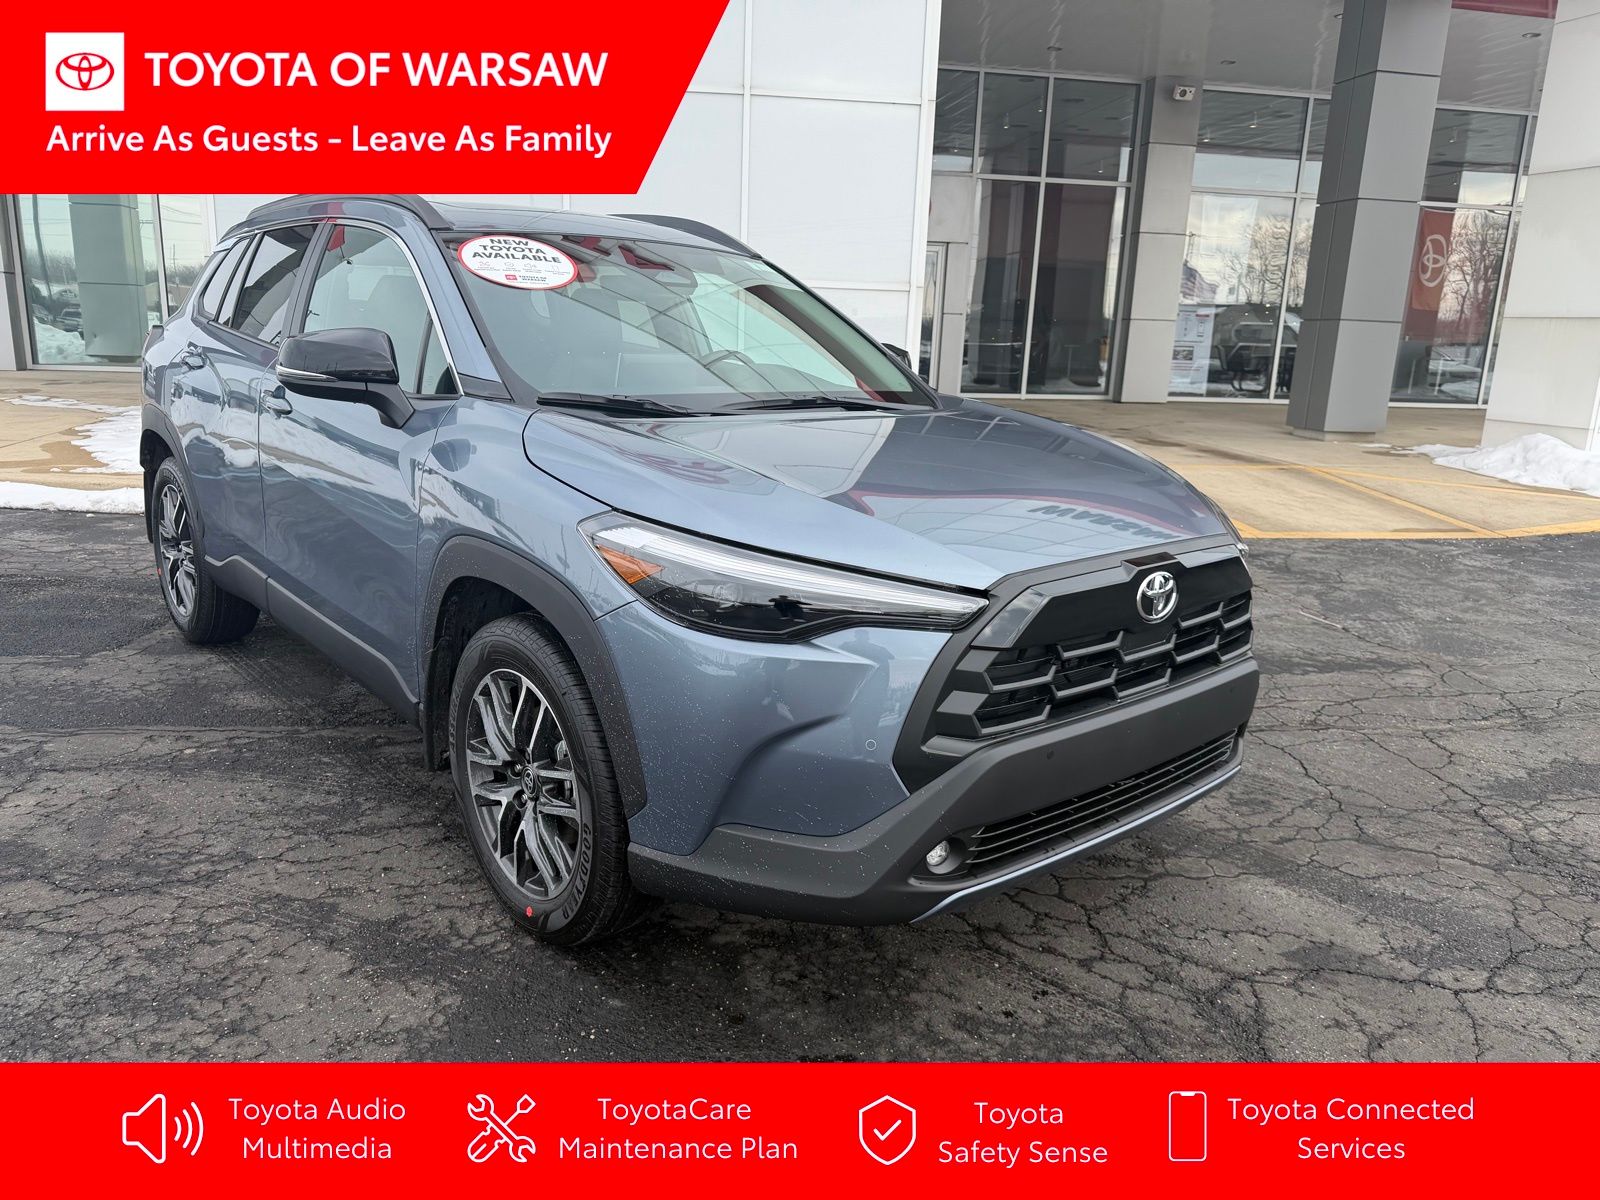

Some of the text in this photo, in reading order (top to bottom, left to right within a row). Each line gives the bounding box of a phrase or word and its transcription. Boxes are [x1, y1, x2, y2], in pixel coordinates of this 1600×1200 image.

[489, 238, 529, 246] NEW
[479, 245, 547, 255] TOYOTA
[472, 252, 562, 263] AVAILABLE
